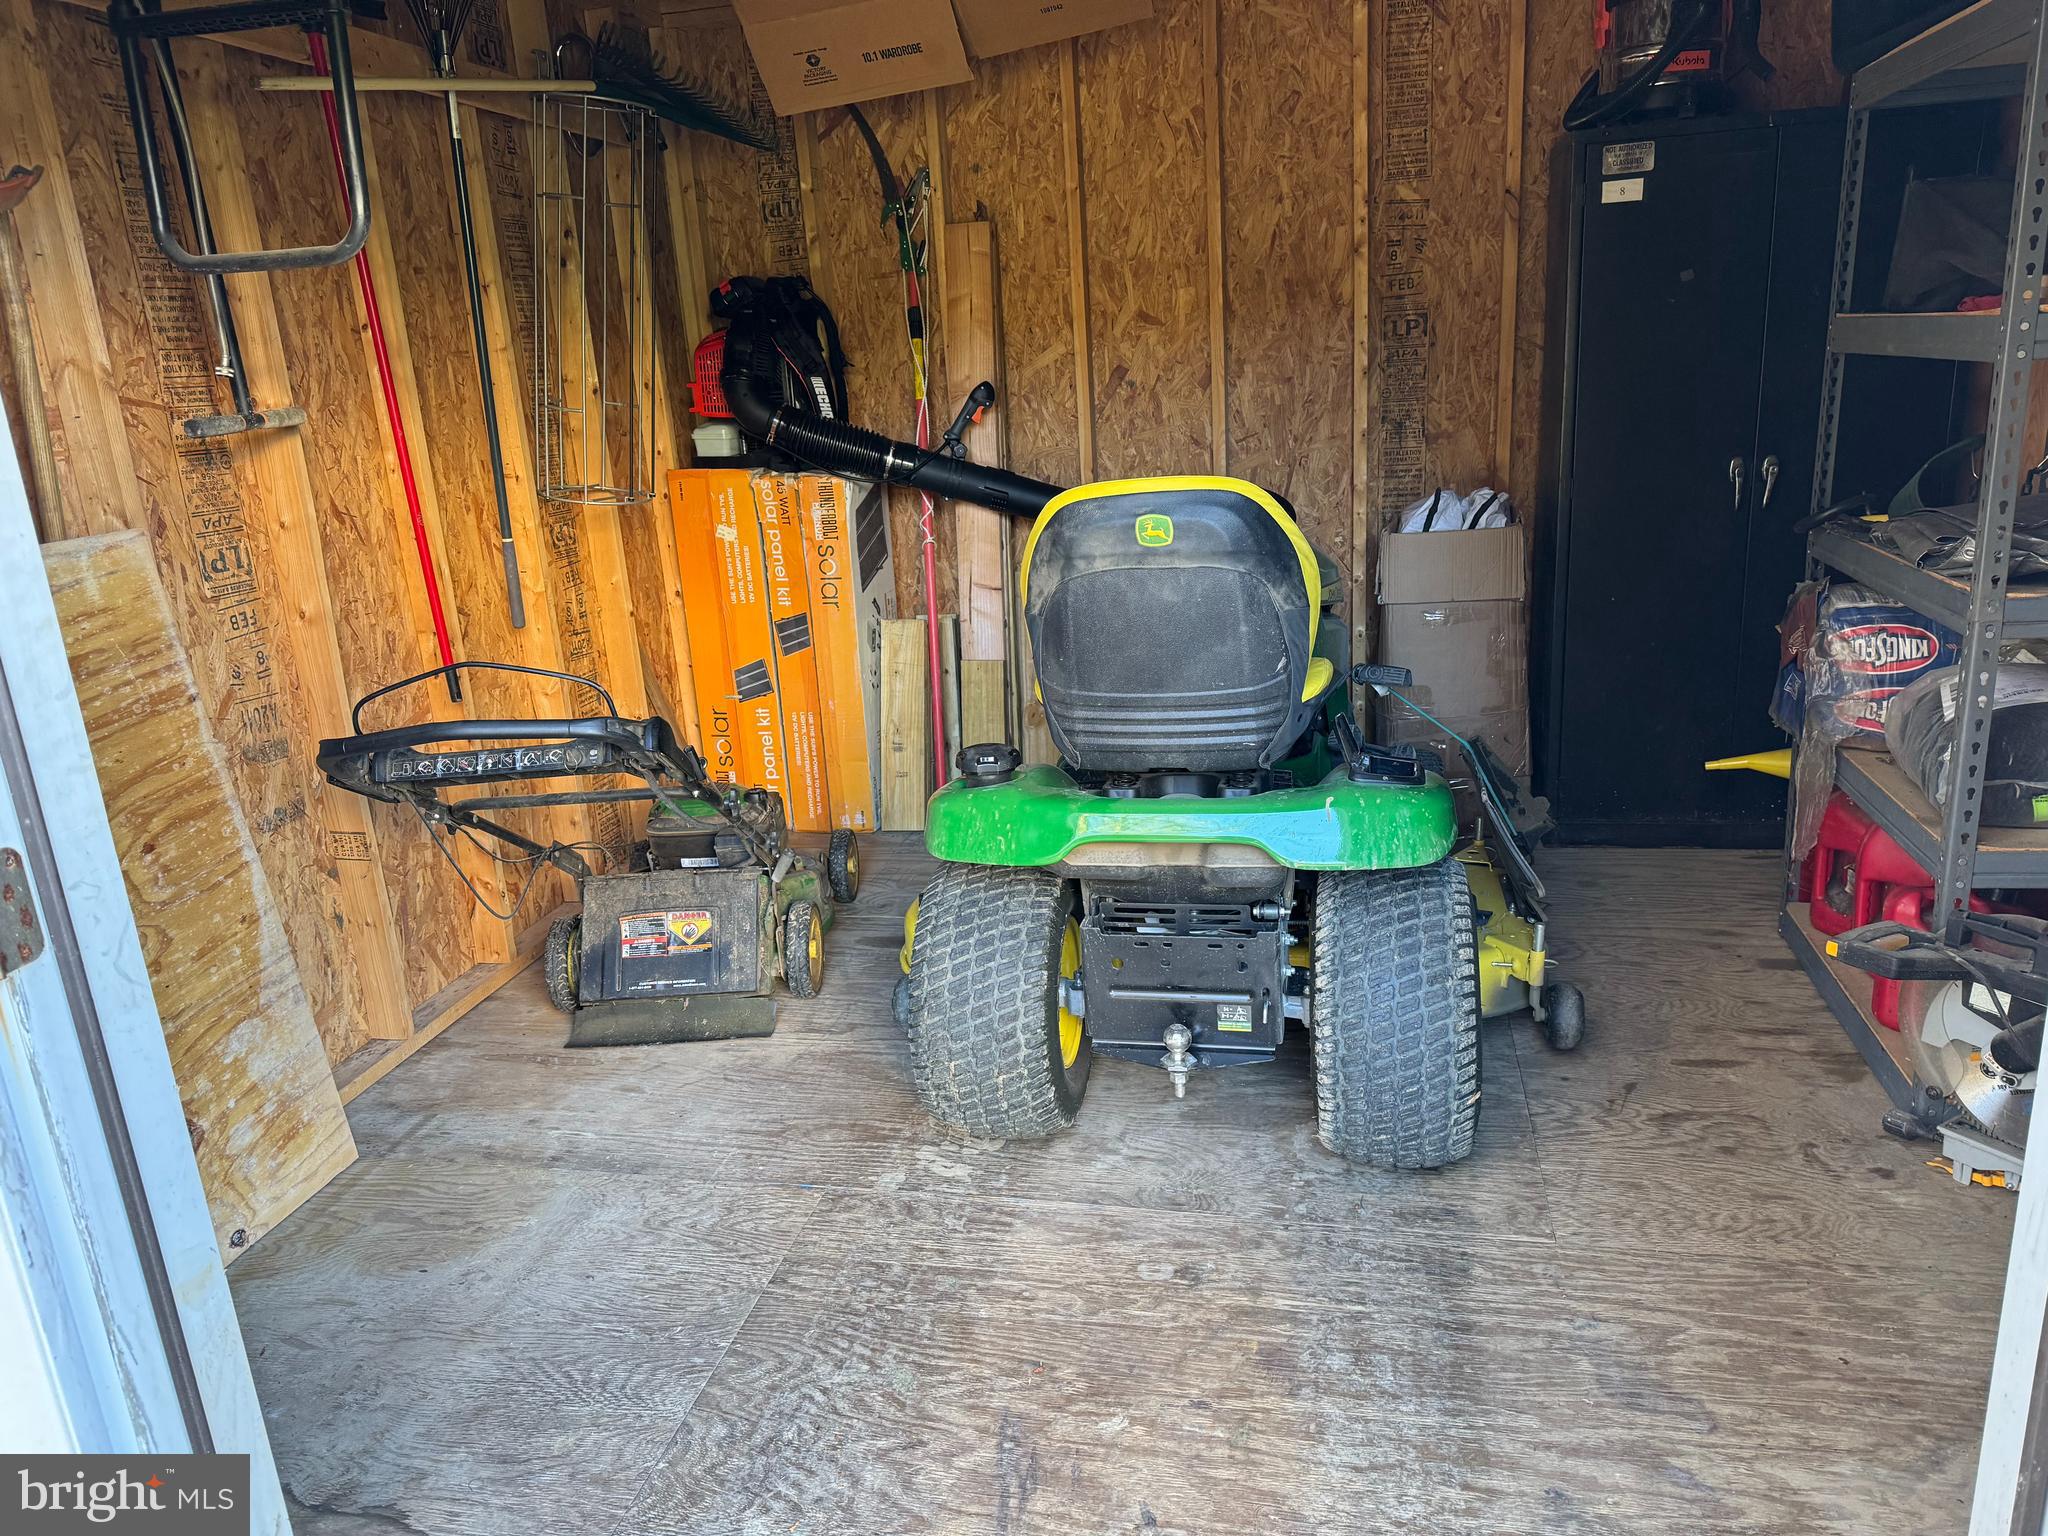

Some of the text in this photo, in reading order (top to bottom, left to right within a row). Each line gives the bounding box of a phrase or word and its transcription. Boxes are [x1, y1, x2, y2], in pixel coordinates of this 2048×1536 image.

[861, 42, 924, 63] 10.1 WARDROBE
[1671, 55, 1705, 66] Kubota
[1619, 186, 1626, 196] 8
[778, 245, 800, 258] FEB
[1390, 277, 1415, 292] FEB
[1391, 319, 1420, 336] LP
[727, 487, 737, 523] RECHARGE
[779, 497, 791, 526] WATT
[201, 513, 234, 529] APA
[760, 480, 792, 607] solar panel kit
[817, 480, 843, 610] THUNDERBOLT solar
[210, 545, 243, 574] LP
[748, 581, 754, 591] DC
[229, 608, 258, 632] FEB
[1848, 631, 1929, 666] KINGSFO
[755, 707, 770, 726] kit
[712, 708, 733, 767] solar
[758, 732, 780, 781] panel
[814, 779, 819, 788] TO
[671, 912, 707, 920] DANGER
